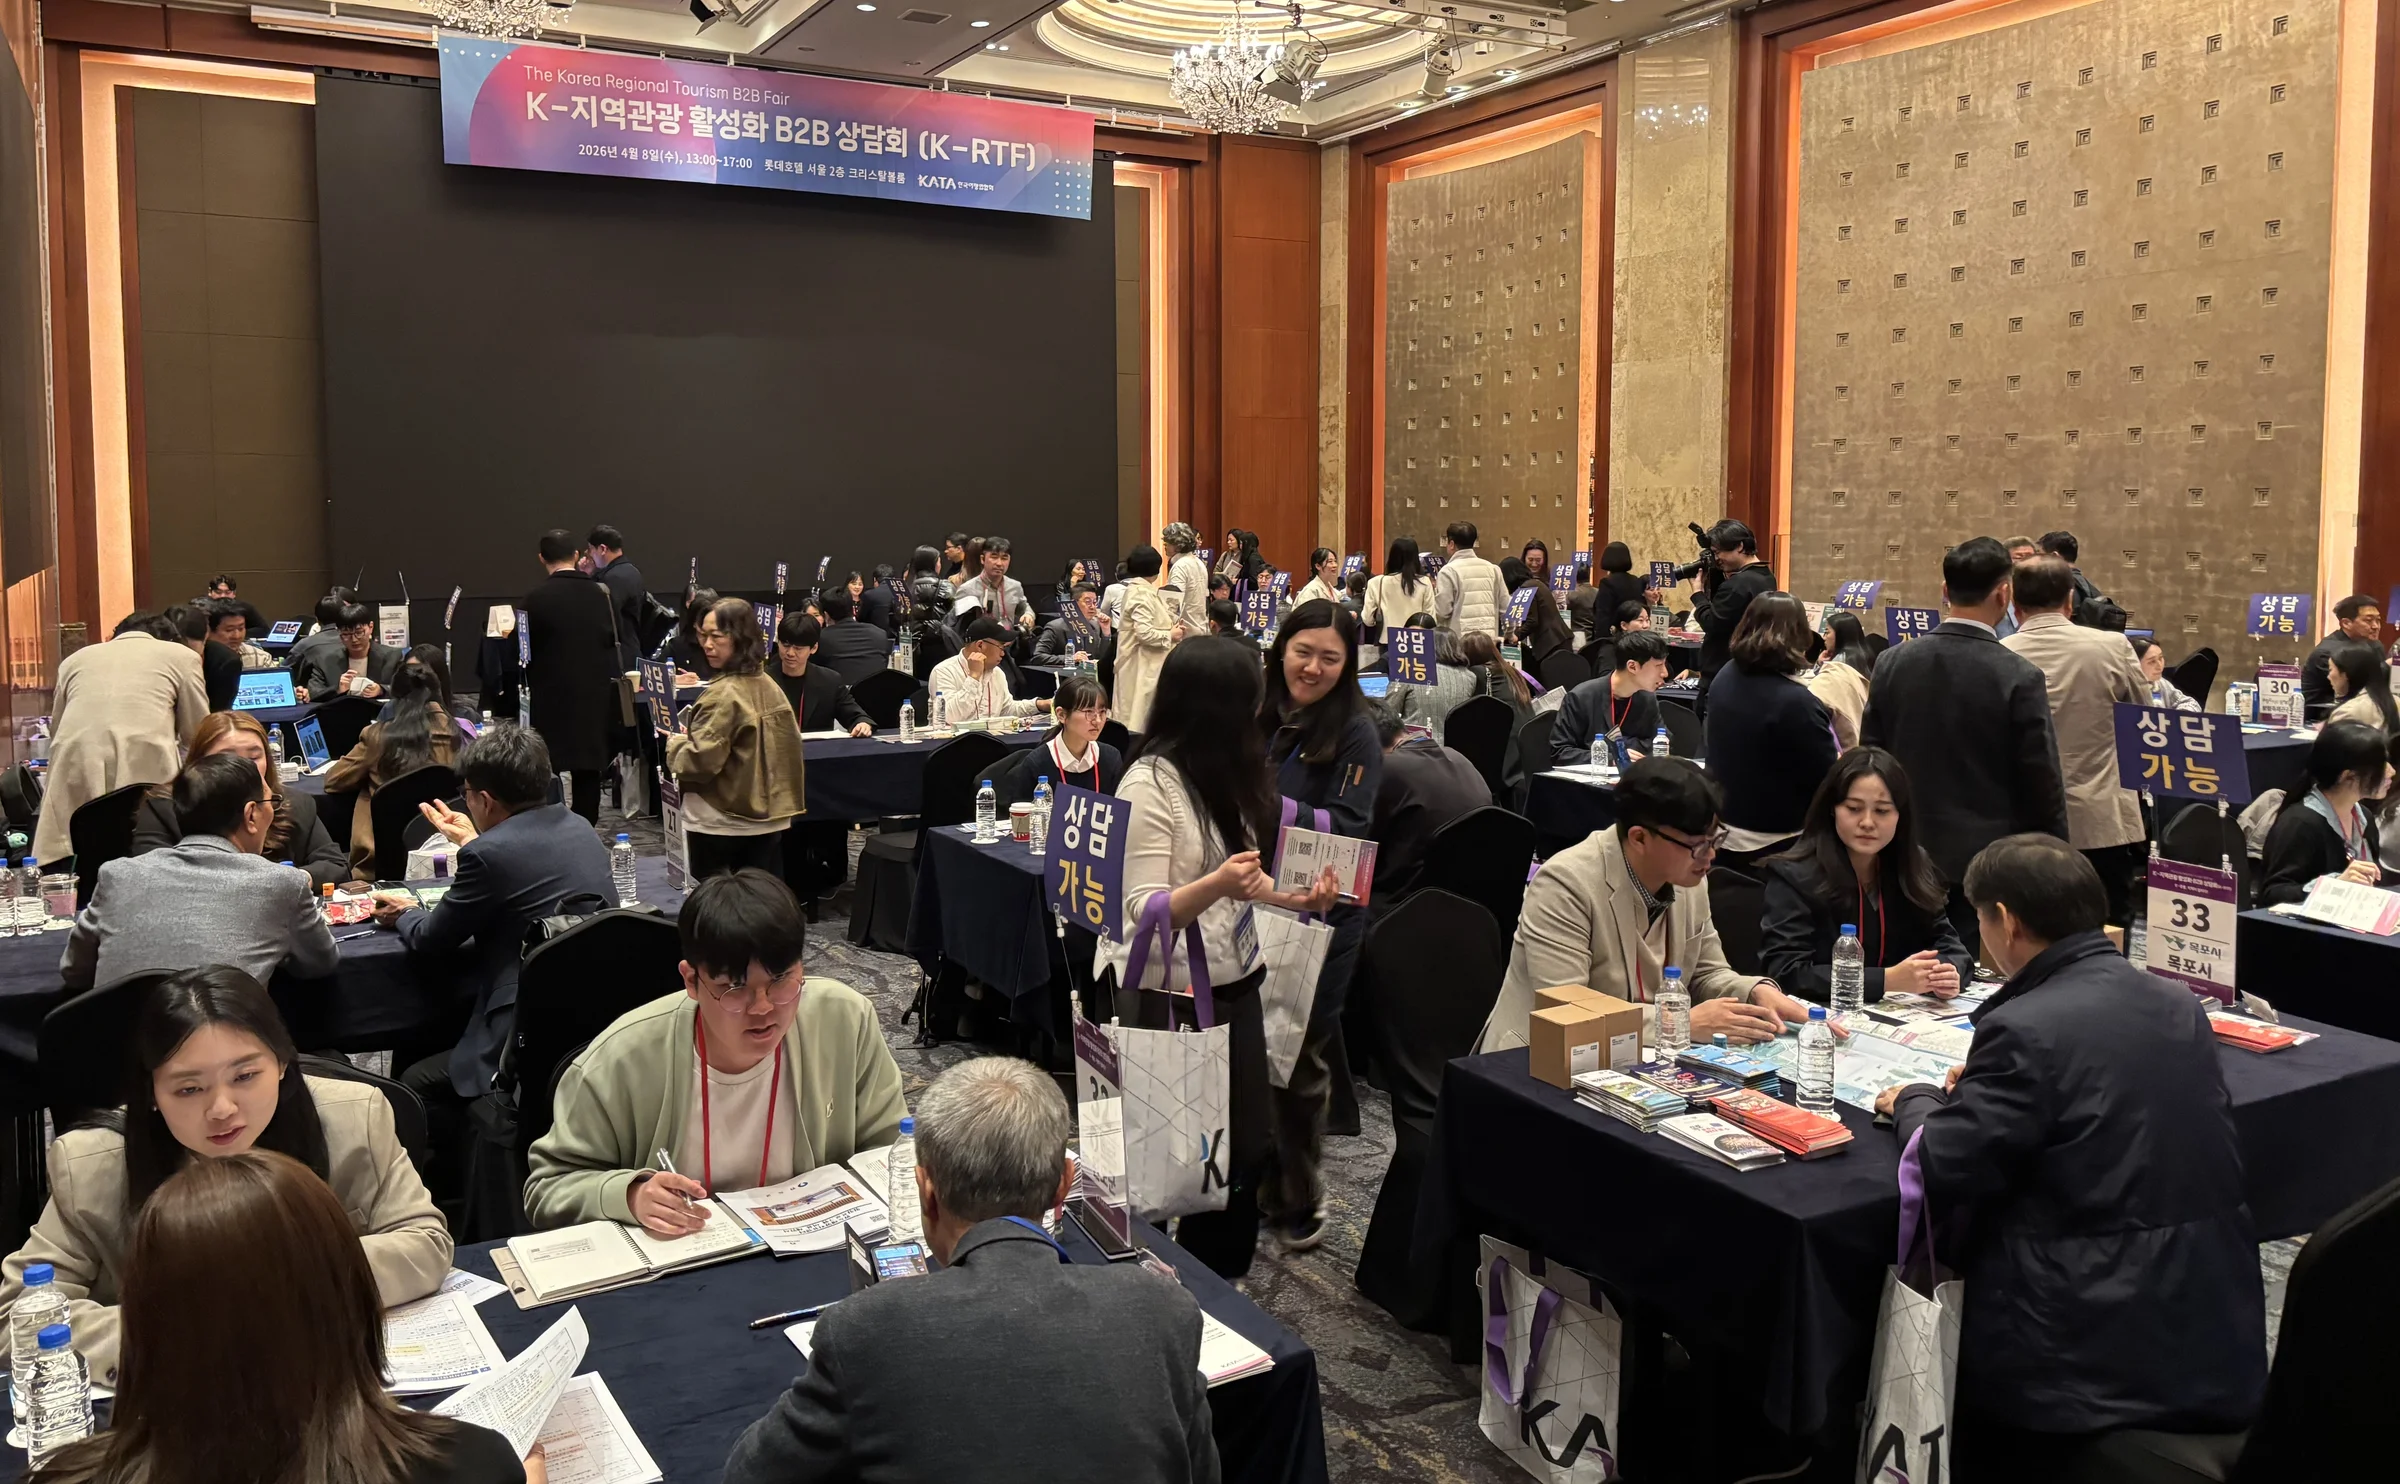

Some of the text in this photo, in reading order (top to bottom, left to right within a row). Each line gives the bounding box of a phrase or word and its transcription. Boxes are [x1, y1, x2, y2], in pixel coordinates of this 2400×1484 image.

[524, 66, 790, 106] The Korea Regional Tourism B2B Fair
[526, 91, 1036, 171] K-지역관광 활성화 B2B 상담회 (K-RTF)
[578, 144, 906, 185] 2026년 4월 8일(수), 13:00~17:00 롯데호텔 서울 2층 크리스탈볼룸
[917, 173, 957, 191] KATA
[1575, 552, 1588, 562] 상담
[1556, 565, 1574, 577] 상담
[1554, 577, 1571, 589] 가능
[1848, 582, 1874, 593] 상담
[1248, 592, 1271, 609] 상담
[1514, 589, 1533, 604] 상담
[1842, 594, 1866, 607] 가능
[2260, 596, 2299, 613] 상담
[757, 606, 772, 627] 상담
[1247, 611, 1268, 628] 가능
[1509, 604, 1525, 619] 가능
[1895, 610, 1929, 631] 상담
[2259, 615, 2295, 633] 가능
[1395, 631, 1425, 654] 상담
[644, 664, 663, 694] 상담
[1397, 657, 1427, 681] 가능
[2270, 680, 2290, 694] 30
[650, 696, 672, 728] 가능
[2137, 711, 2216, 753] 상담
[2141, 753, 2220, 794] 가능
[667, 810, 677, 833] 27
[1064, 795, 1114, 859] 상담
[1058, 858, 1105, 925] 가능
[2170, 898, 2210, 933] 33
[2189, 941, 2222, 960] 목포시
[2167, 954, 2212, 980] 목포시
